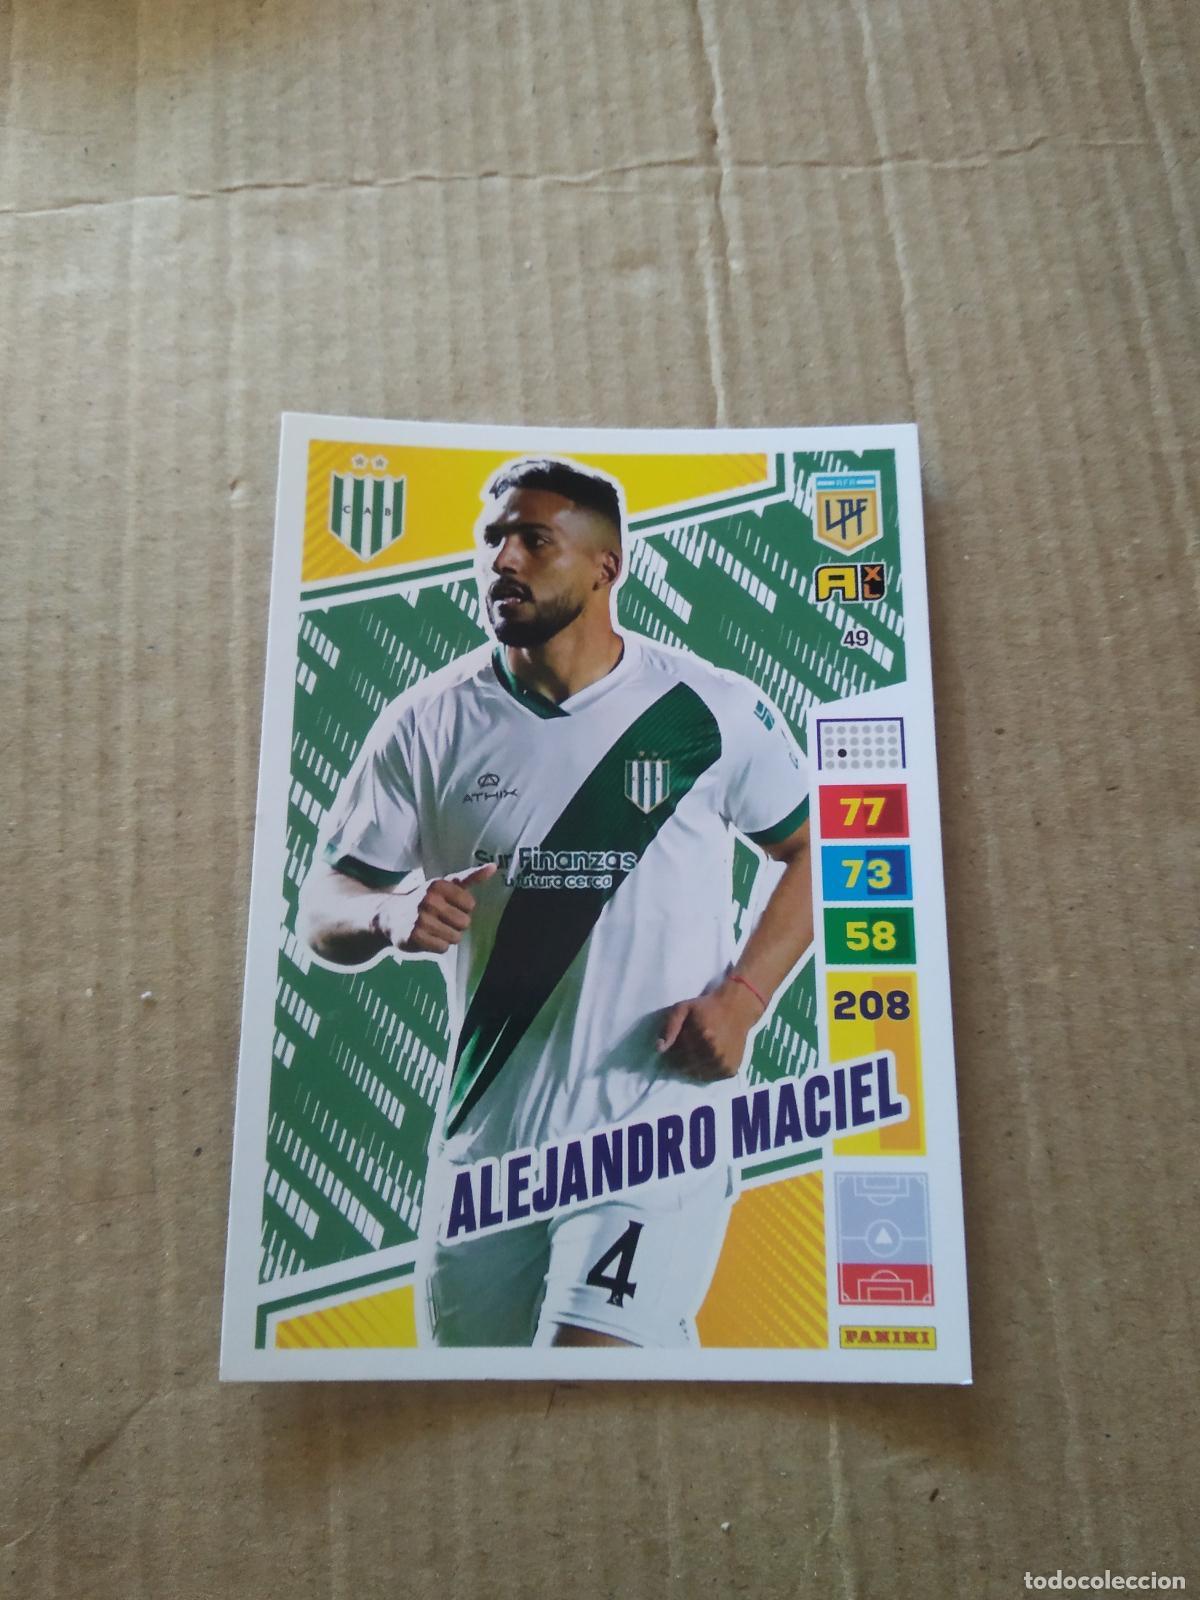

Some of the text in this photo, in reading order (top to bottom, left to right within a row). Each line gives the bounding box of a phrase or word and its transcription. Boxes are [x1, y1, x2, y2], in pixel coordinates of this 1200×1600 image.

[843, 629, 869, 647] 49
[462, 787, 519, 804] ATHIX
[839, 796, 886, 826] 77
[518, 845, 637, 872] Finanzas
[841, 859, 892, 890] 73
[846, 920, 897, 952] 58
[833, 989, 911, 1021] 208
[446, 1056, 903, 1239] ALEJANDRO MACIEL
[586, 1219, 645, 1309] 4
[844, 1329, 930, 1345] PANINI
